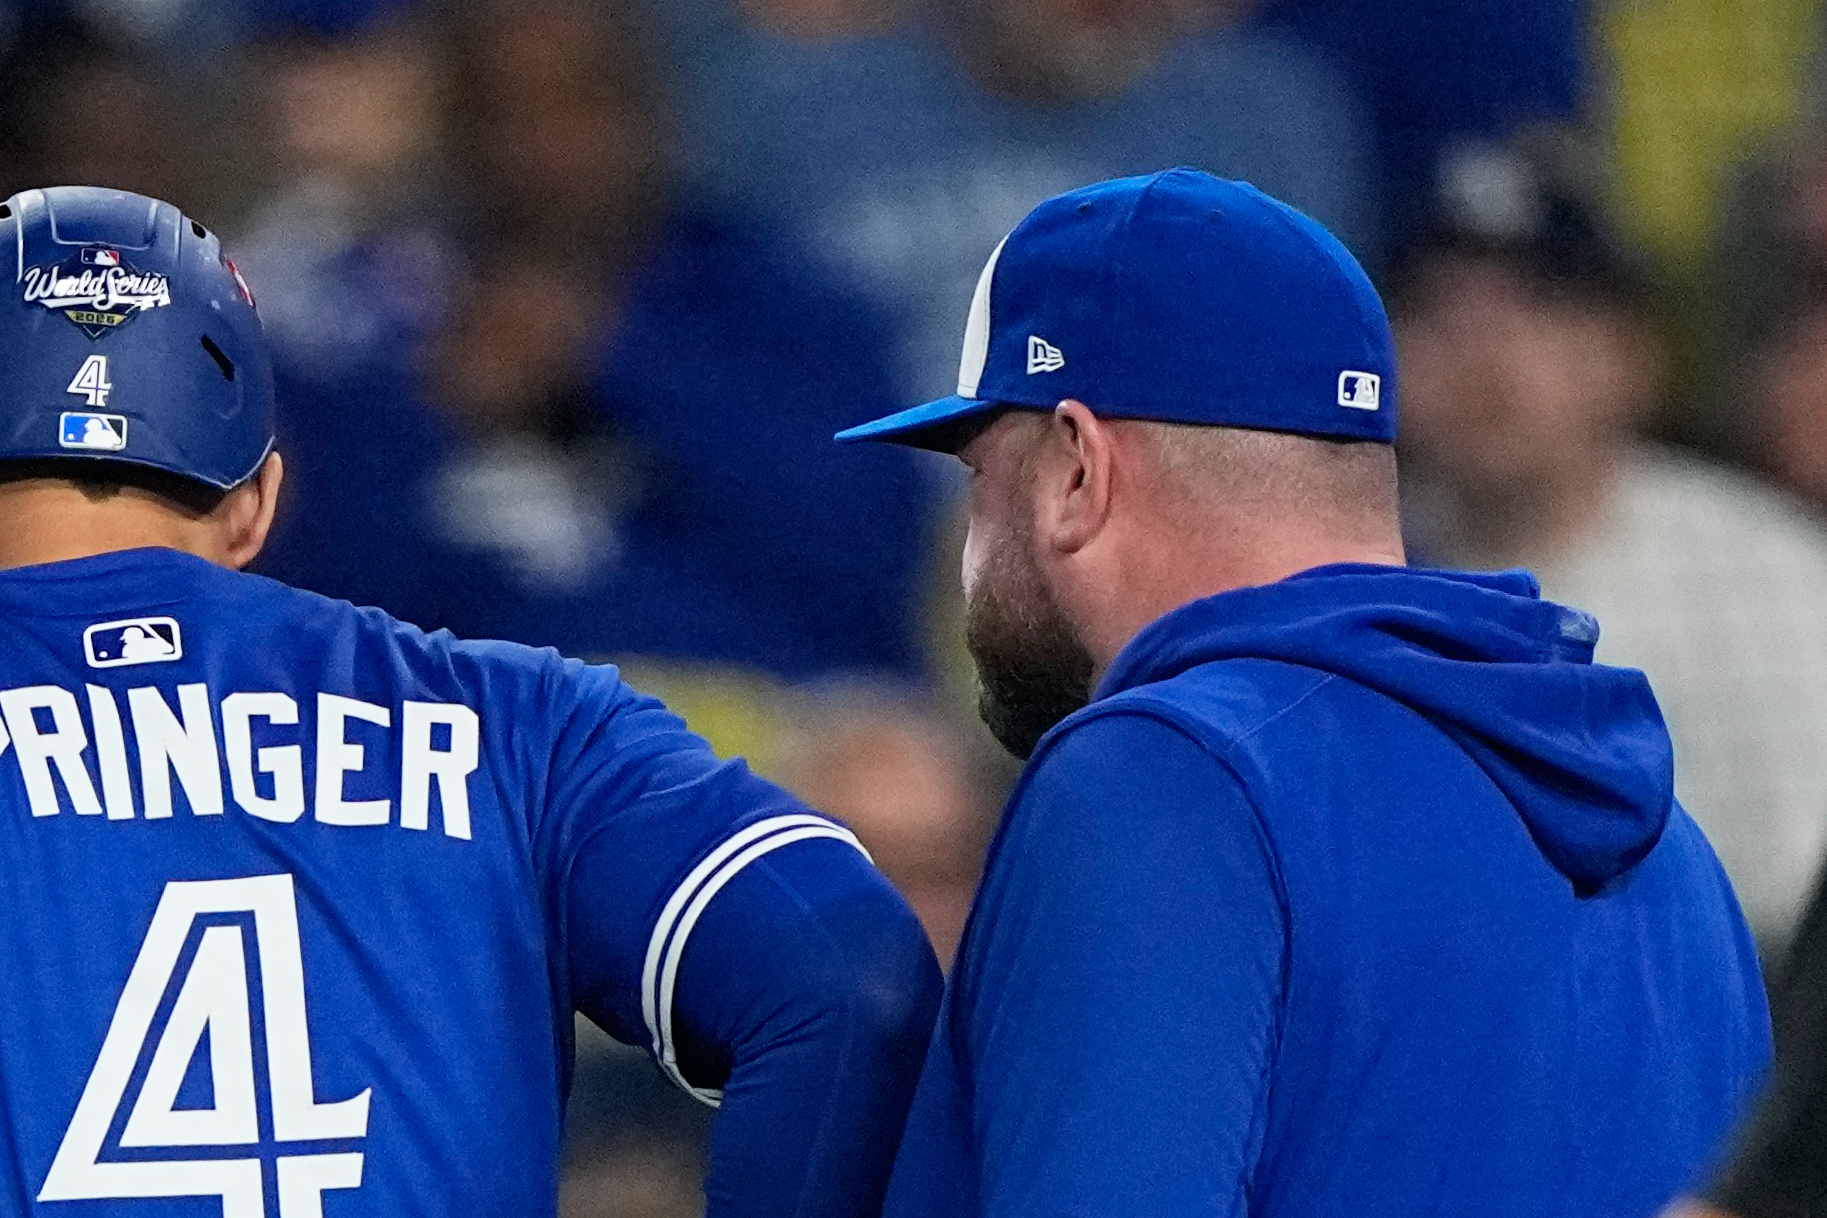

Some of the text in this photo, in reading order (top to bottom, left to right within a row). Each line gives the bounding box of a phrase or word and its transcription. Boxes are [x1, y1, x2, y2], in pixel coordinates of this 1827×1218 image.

[24, 266, 170, 311] World Series
[66, 354, 112, 407] 4
